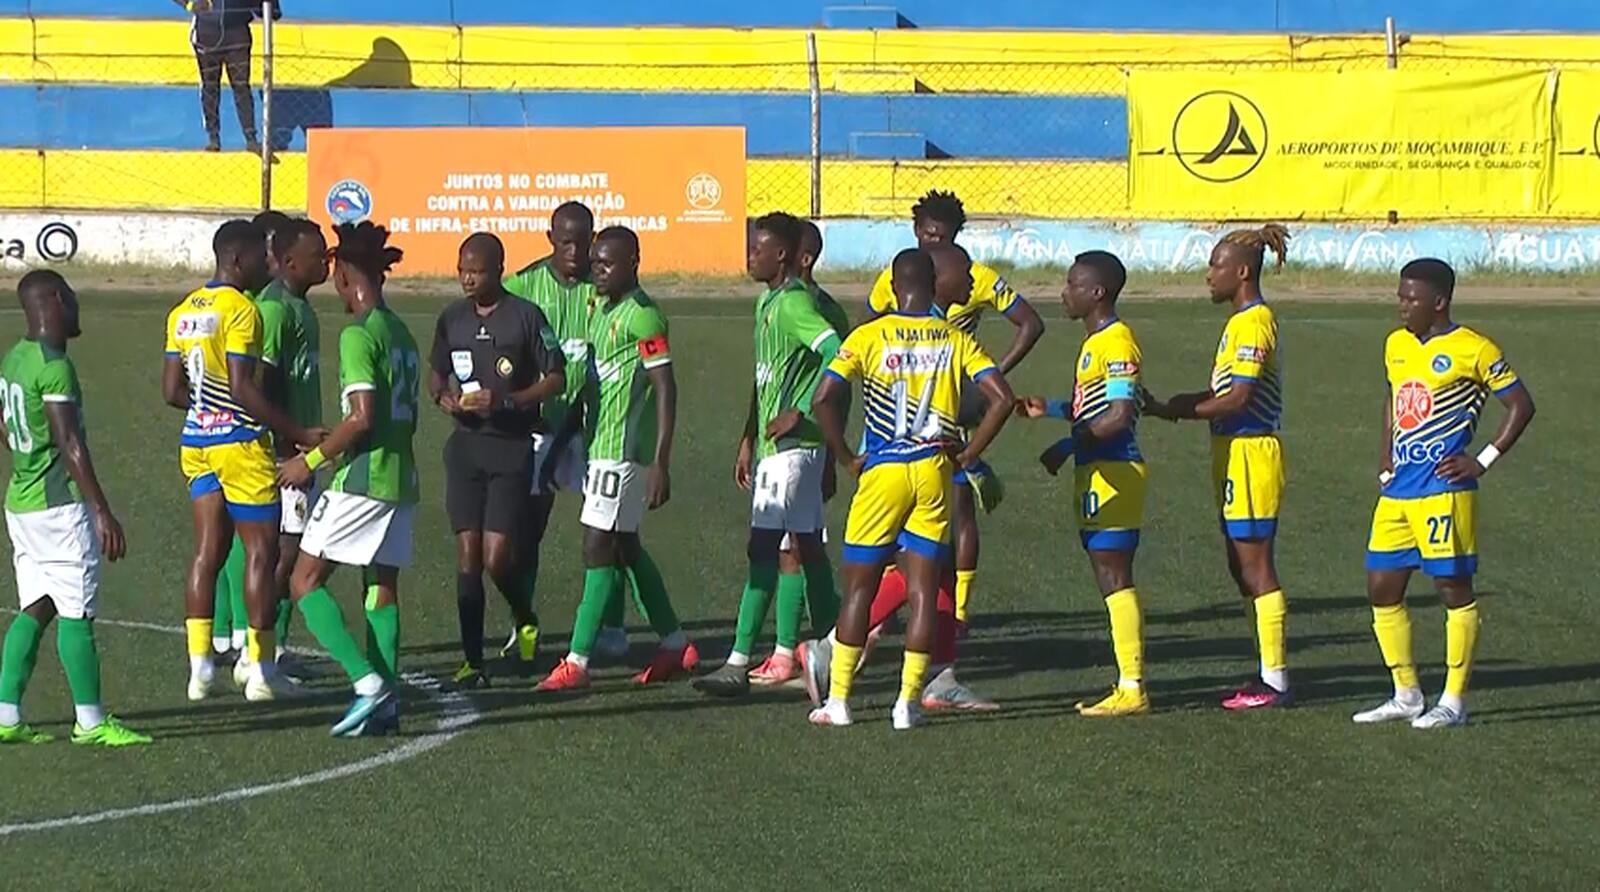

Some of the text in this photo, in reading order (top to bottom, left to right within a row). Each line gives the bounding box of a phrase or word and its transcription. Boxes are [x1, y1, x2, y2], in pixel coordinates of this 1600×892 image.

[1277, 142, 1378, 155] AEROPORTOS
[1407, 160, 1470, 170] SEGURANÇA
[1484, 160, 1541, 169] QUALIDADE
[443, 173, 608, 189] JUNTOS NO COMBATE
[427, 195, 489, 211] CONTRA
[494, 195, 504, 210] A
[390, 217, 410, 232] DE
[415, 216, 551, 233] INFRA-ESTRUTUR
[645, 340, 658, 355] C
[591, 468, 621, 499] 10
[1427, 515, 1452, 544] 27
